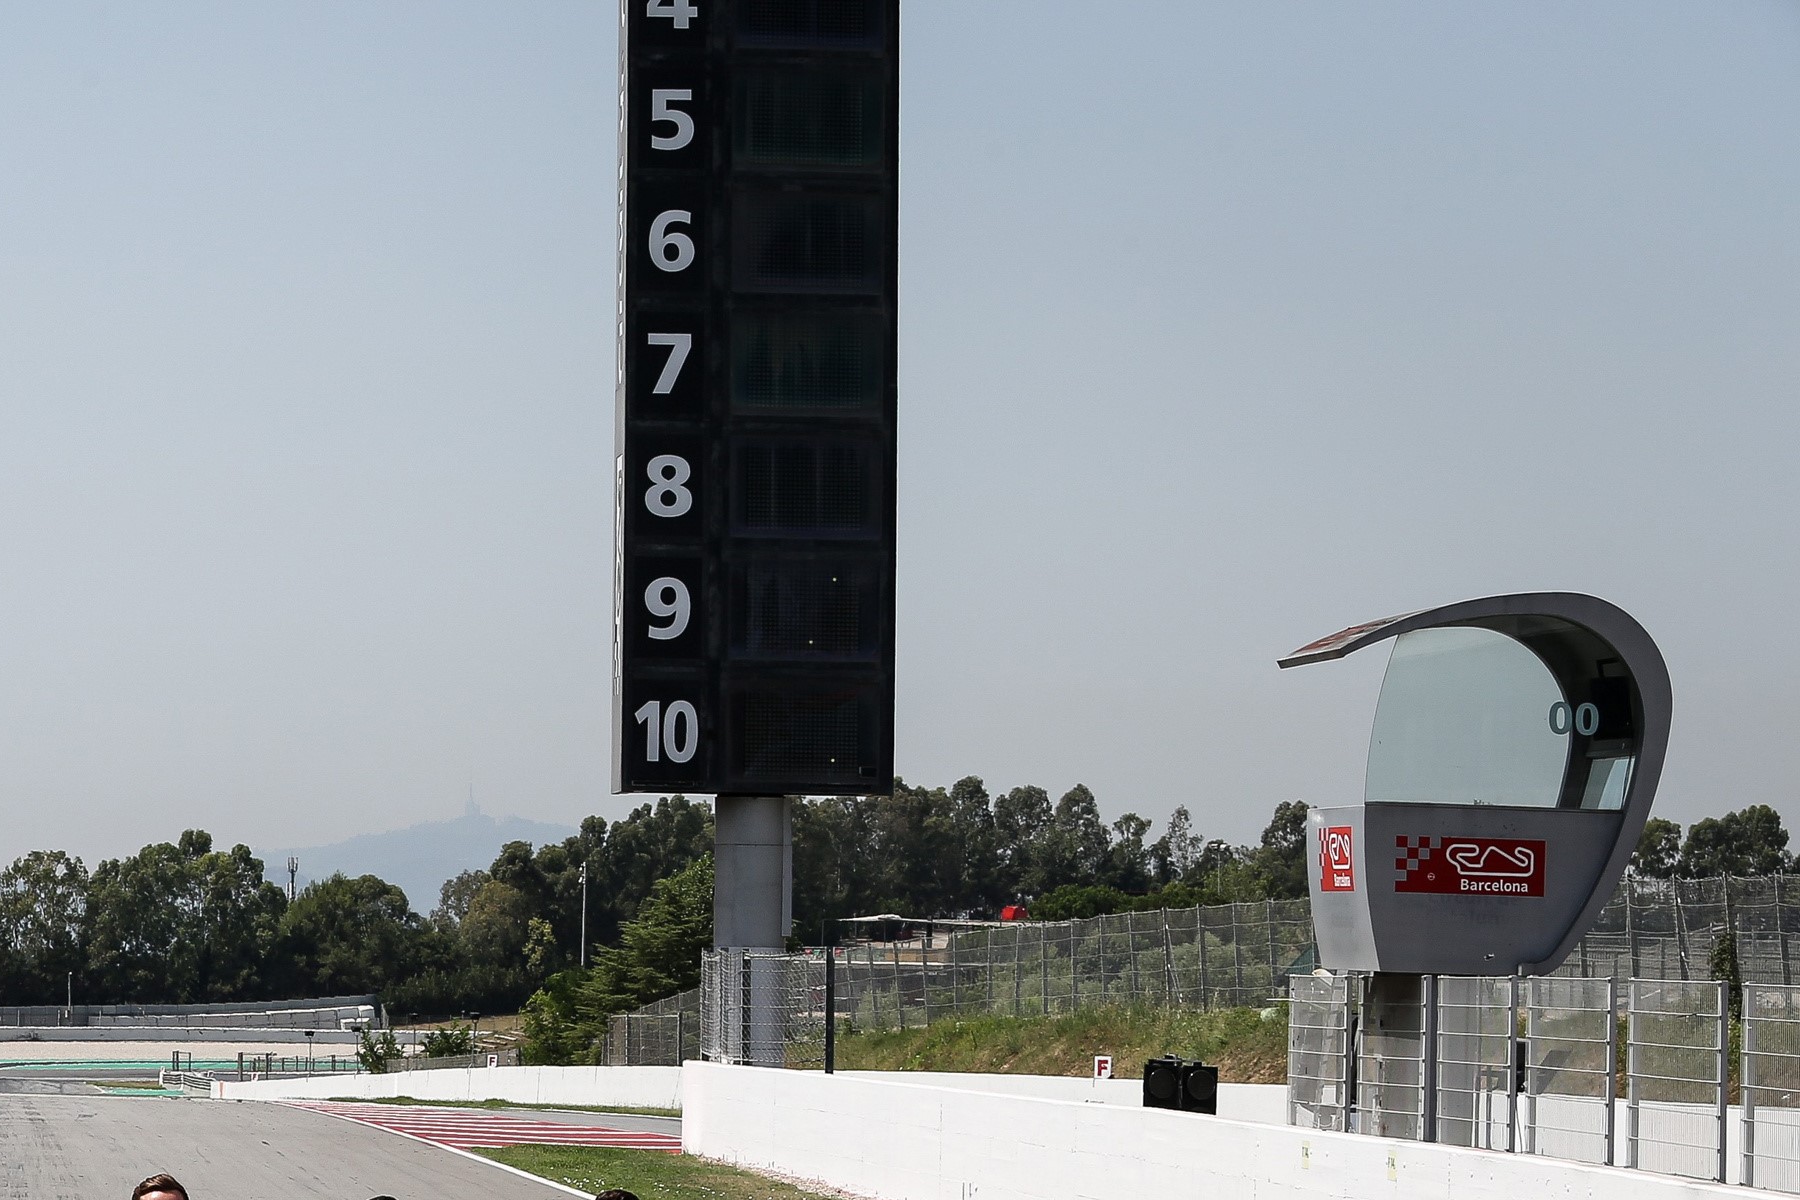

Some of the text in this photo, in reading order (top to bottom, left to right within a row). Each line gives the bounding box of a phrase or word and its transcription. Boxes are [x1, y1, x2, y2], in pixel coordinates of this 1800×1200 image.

[650, 89, 695, 150] 5
[647, 210, 695, 272] 6
[647, 333, 692, 394] 7
[644, 455, 693, 518] 8
[644, 577, 691, 639] 9
[634, 700, 698, 763] 10
[1549, 702, 1599, 735] 00
[1460, 878, 1529, 893] Barcelona
[489, 1057, 496, 1066] F
[1097, 1059, 1109, 1076] F
